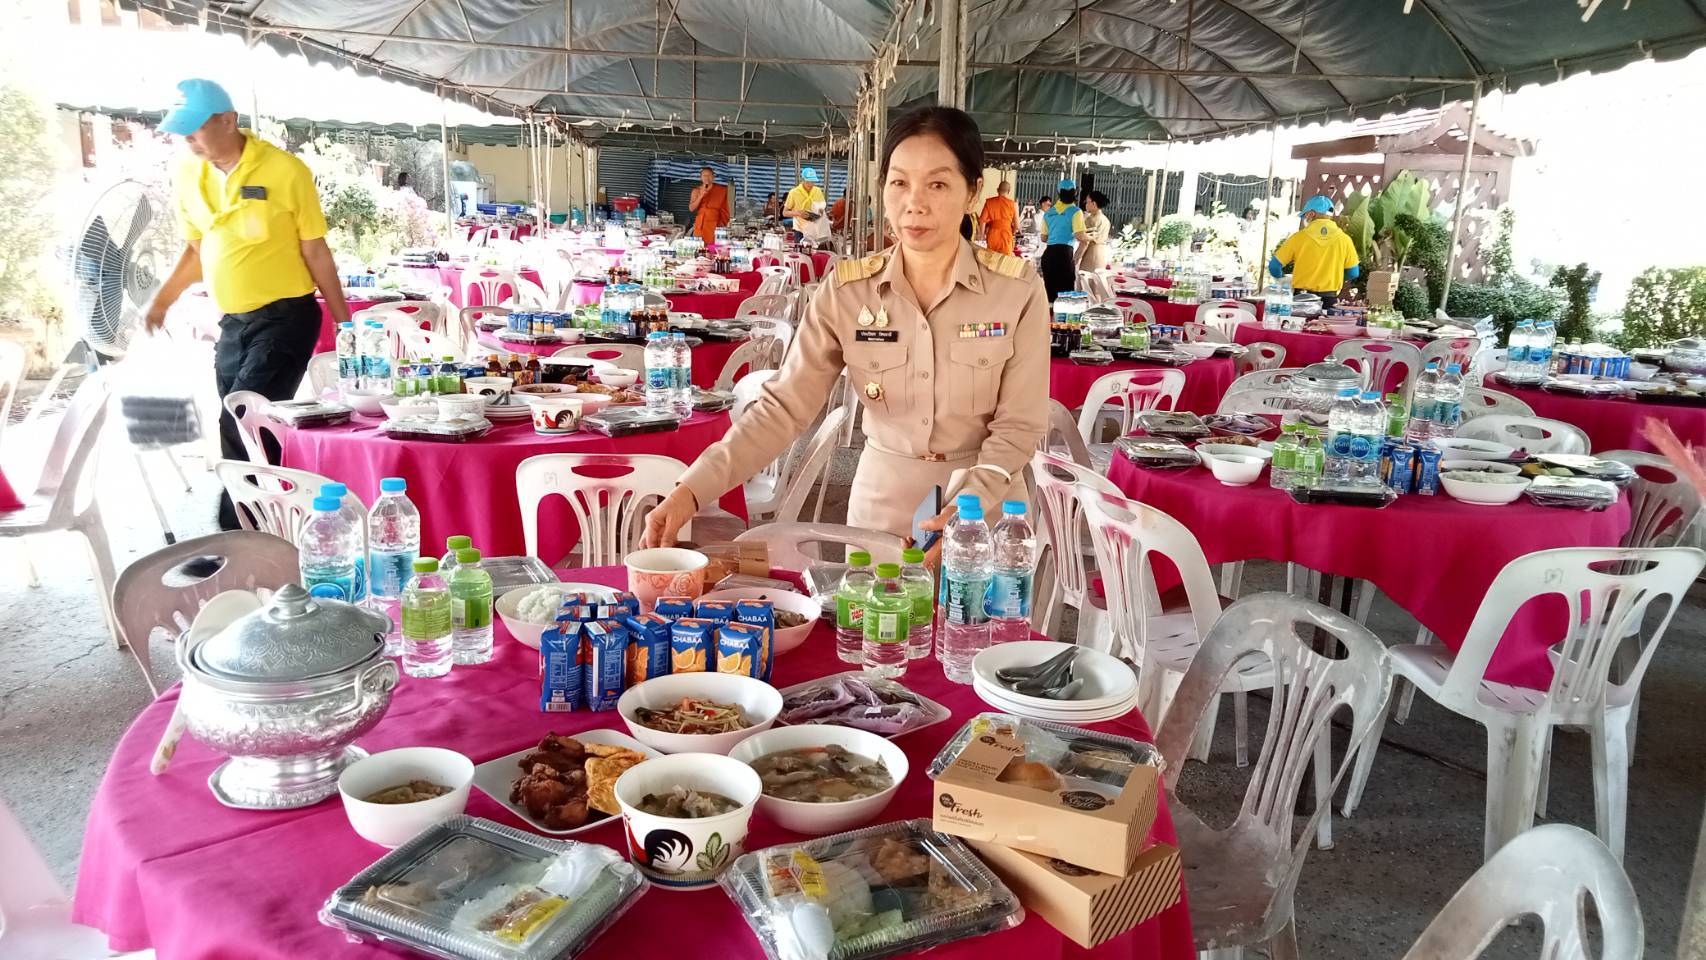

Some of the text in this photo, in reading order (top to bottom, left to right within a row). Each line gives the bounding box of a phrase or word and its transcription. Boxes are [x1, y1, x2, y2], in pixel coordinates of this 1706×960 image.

[738, 615, 768, 623] CHABAA
[672, 635, 703, 644] CHABAA
[719, 638, 750, 649] CHABAA
[951, 802, 983, 818] Fresh
